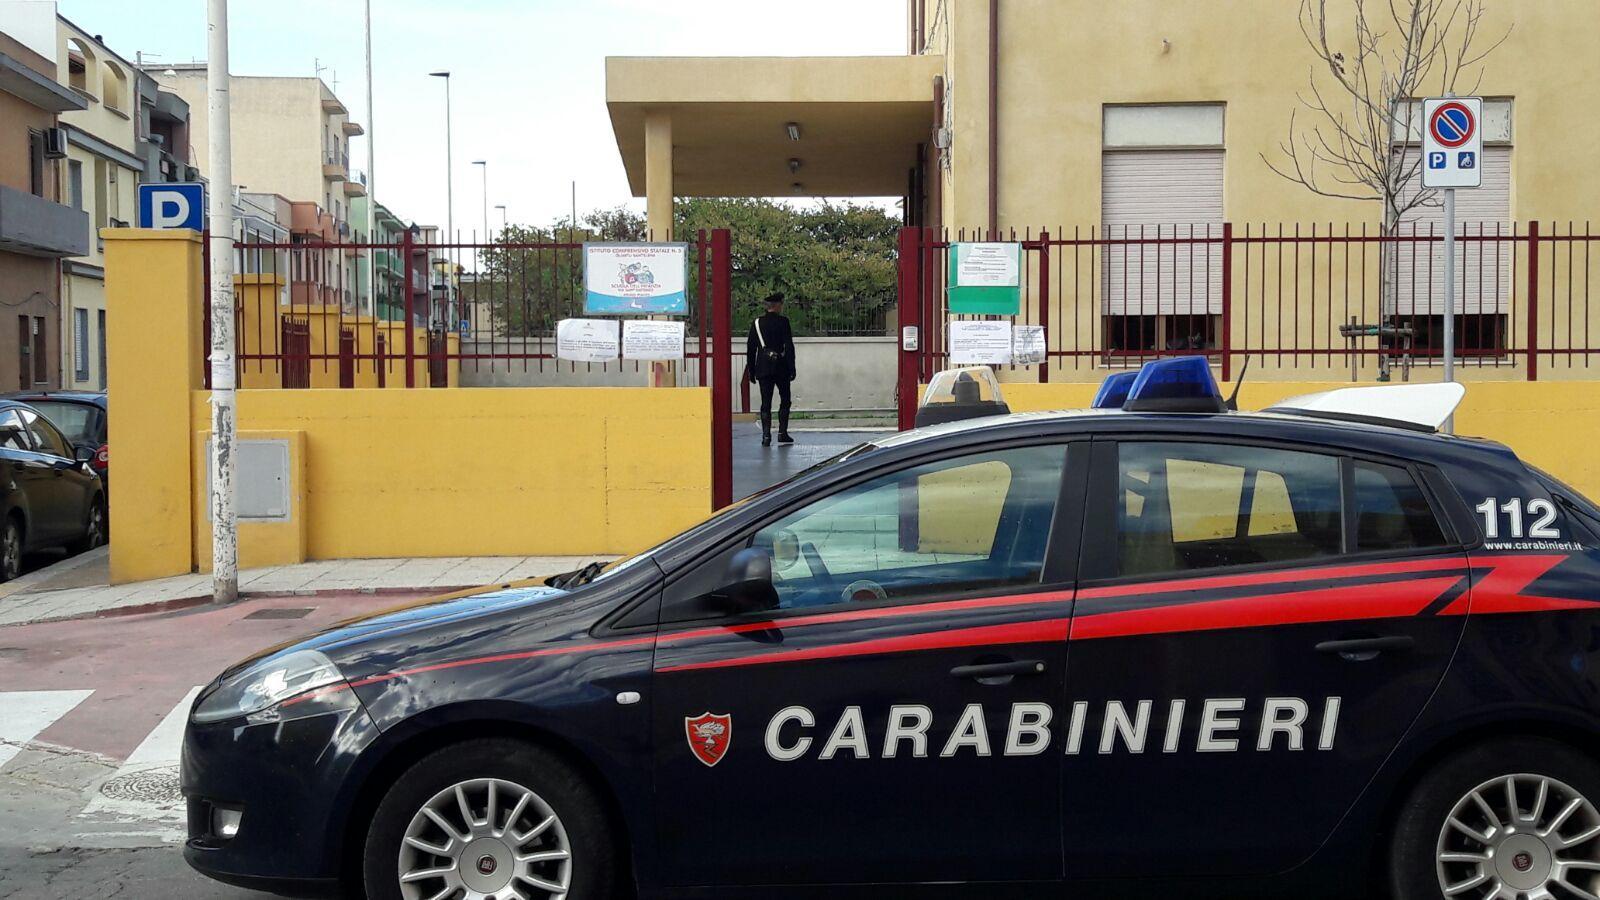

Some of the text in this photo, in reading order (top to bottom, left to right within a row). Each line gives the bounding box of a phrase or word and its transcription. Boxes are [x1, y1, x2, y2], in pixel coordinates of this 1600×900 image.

[1432, 153, 1443, 167] P
[152, 191, 190, 229] P
[1476, 497, 1560, 538] 112
[1484, 540, 1583, 551] www.carabinieri.it
[764, 696, 1341, 762] CARABINIERI
